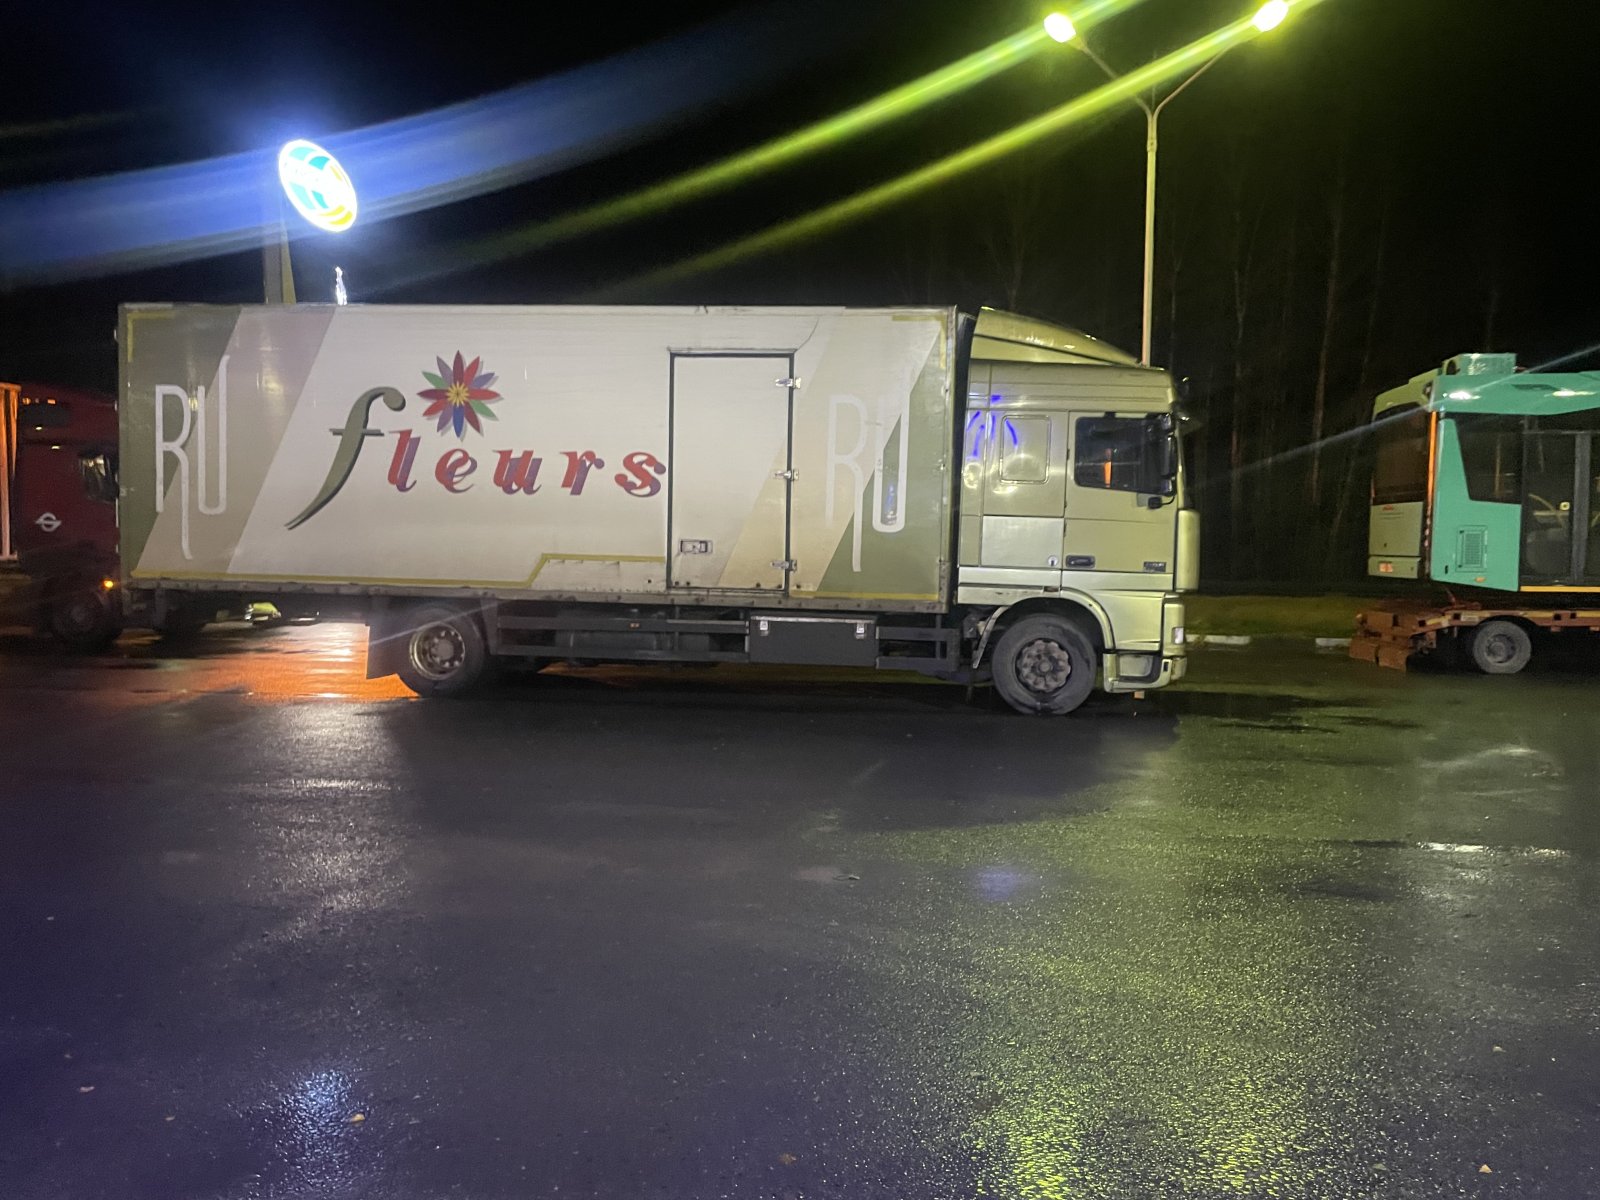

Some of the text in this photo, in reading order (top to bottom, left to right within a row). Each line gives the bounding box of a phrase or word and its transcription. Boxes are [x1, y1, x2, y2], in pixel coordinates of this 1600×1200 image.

[155, 355, 667, 560] RU fleurs
[825, 364, 910, 572] RU
